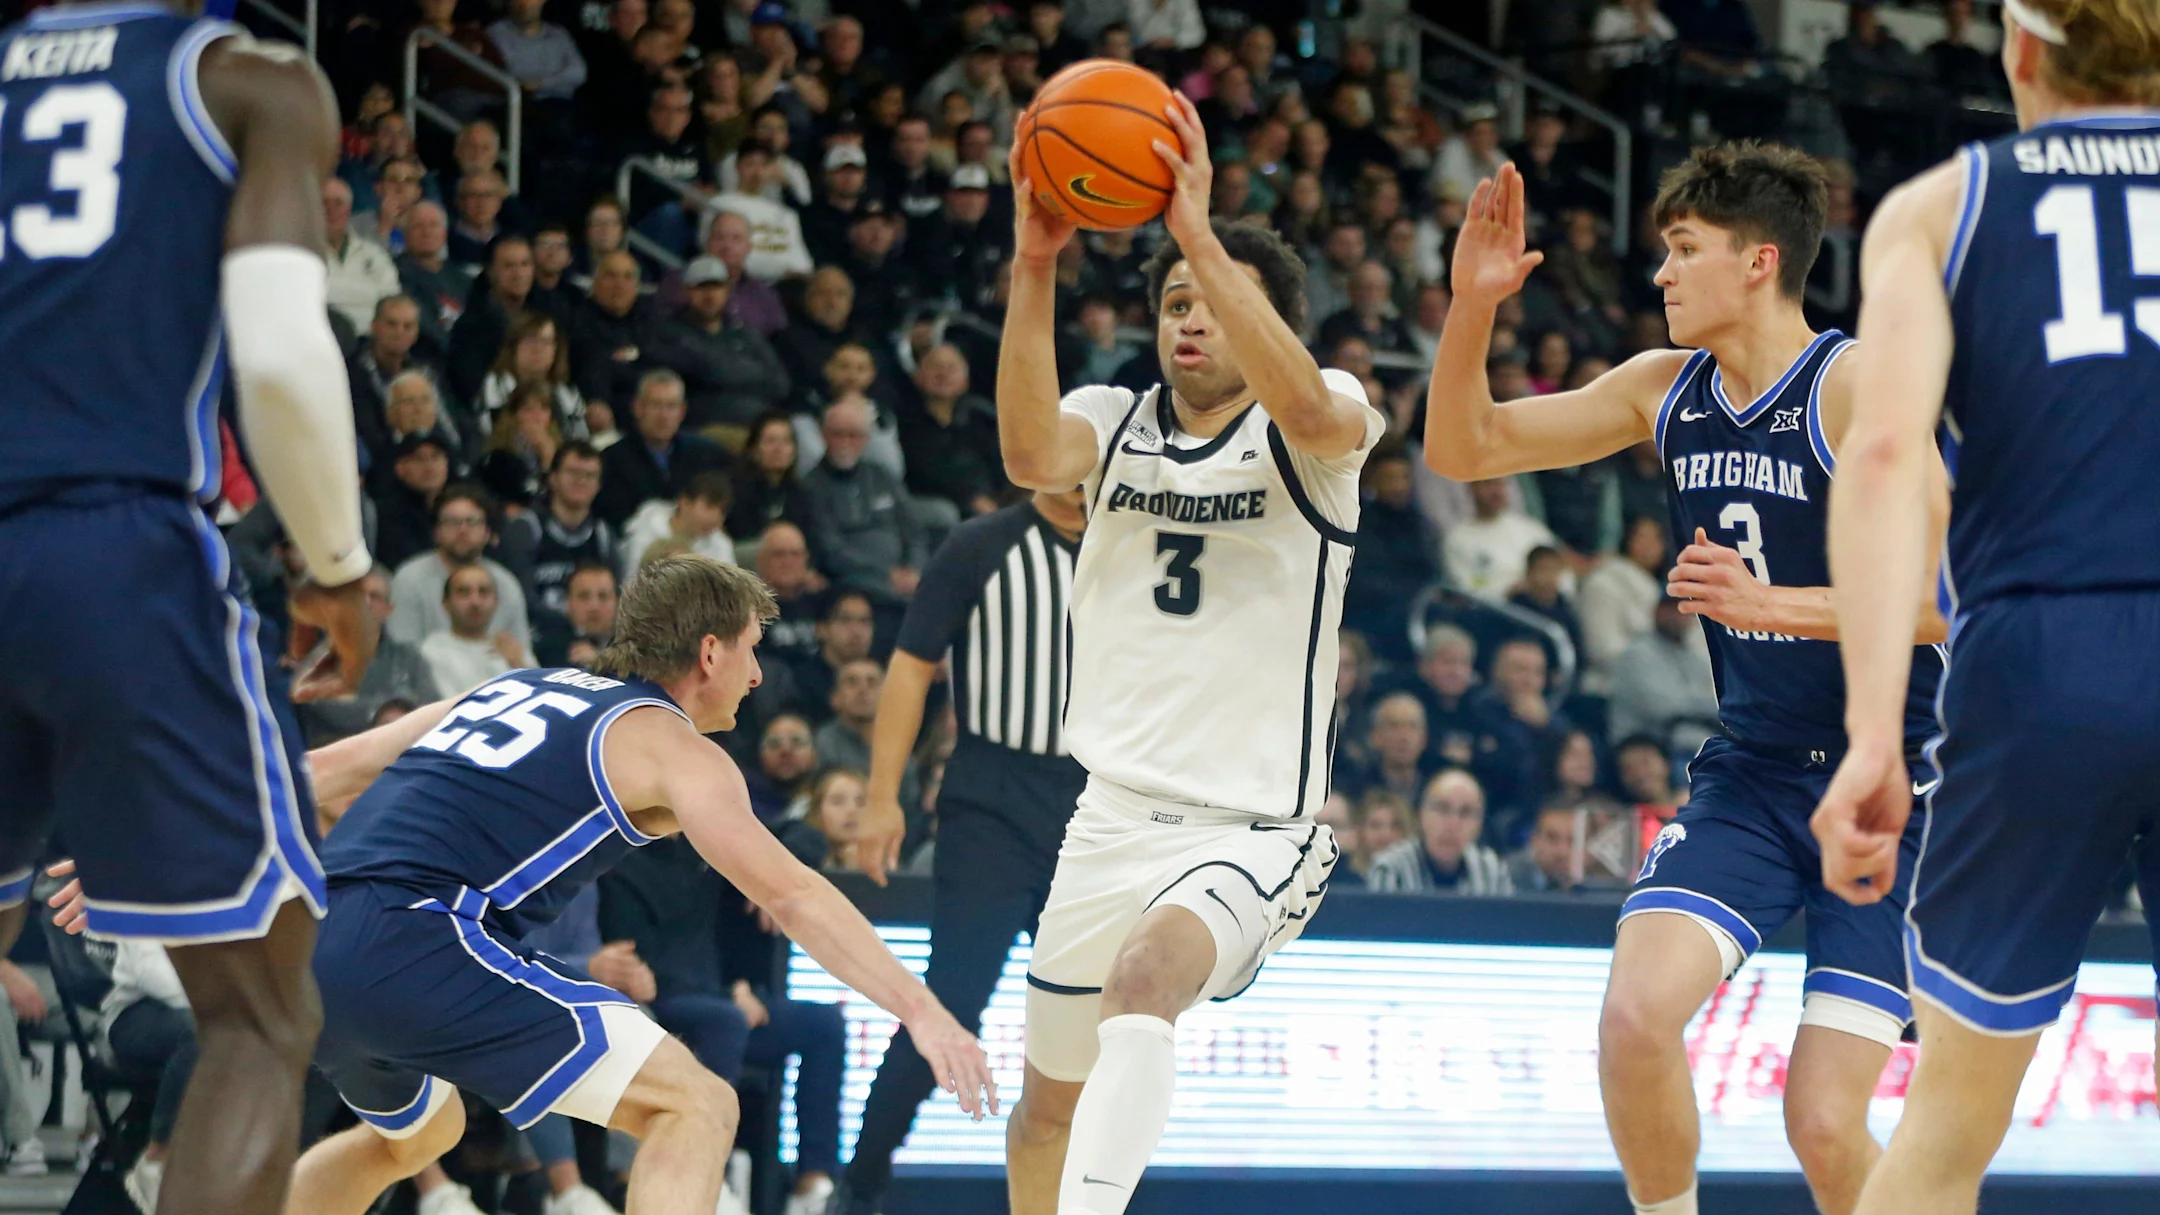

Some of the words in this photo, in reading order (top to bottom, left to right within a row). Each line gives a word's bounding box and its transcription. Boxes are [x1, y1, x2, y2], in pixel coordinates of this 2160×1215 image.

[2, 25, 119, 82] KEITA
[0, 82, 128, 262] 3
[2013, 135, 2160, 175] SAUND
[1126, 426, 1156, 447] CHANGE
[1108, 482, 1266, 523] PROVIDENCE
[1672, 452, 1808, 501] BRIGHAM
[1719, 503, 1771, 586] 3
[1152, 528, 1208, 620] 3
[412, 679, 593, 769] 25
[1150, 811, 1184, 825] FRIARS
